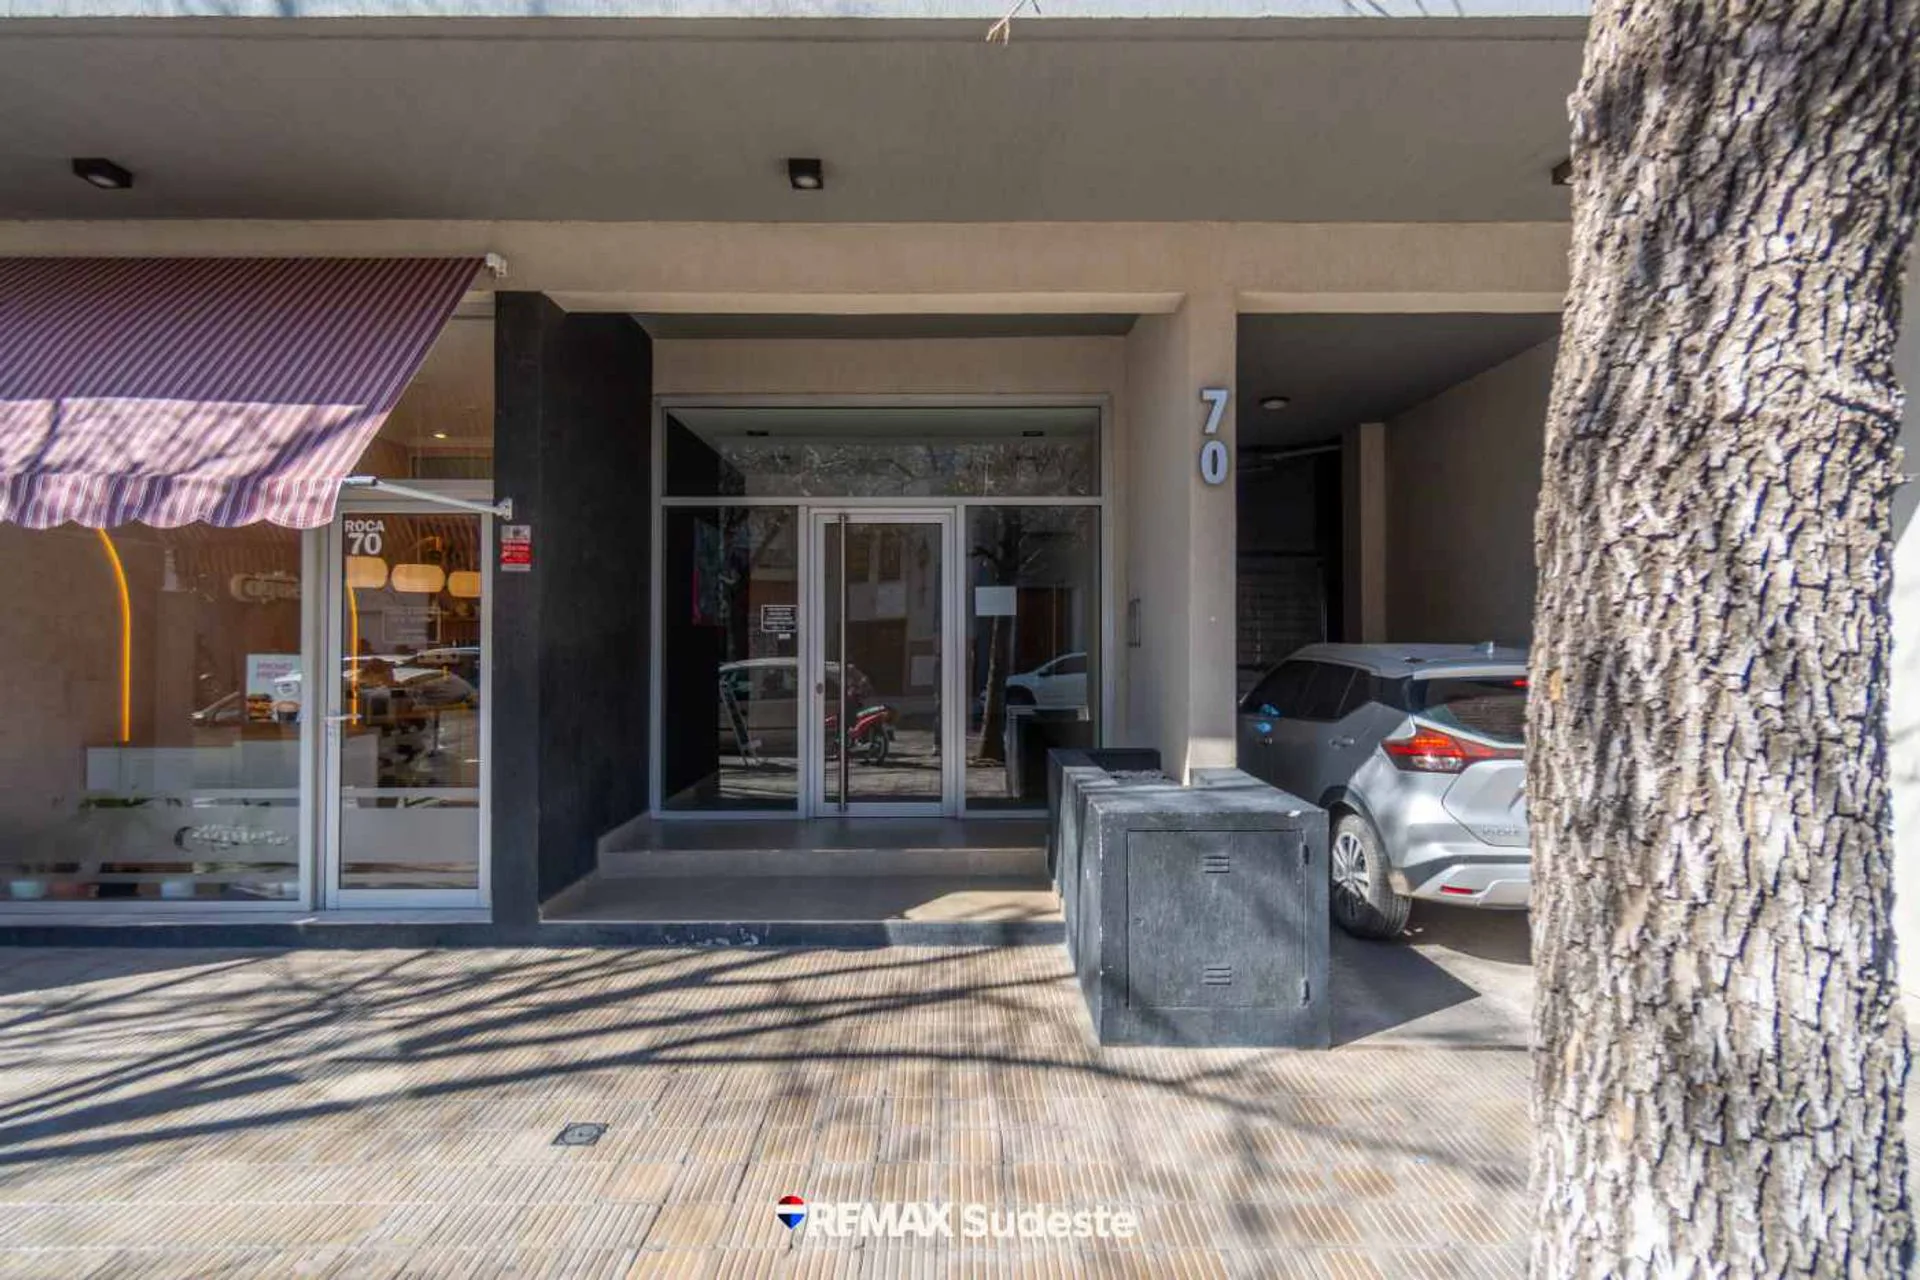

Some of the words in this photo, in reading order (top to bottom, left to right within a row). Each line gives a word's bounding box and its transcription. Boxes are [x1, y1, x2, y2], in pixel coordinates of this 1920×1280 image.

[1201, 388, 1229, 485] 70
[345, 520, 385, 532] ROCA
[348, 532, 382, 555] 70
